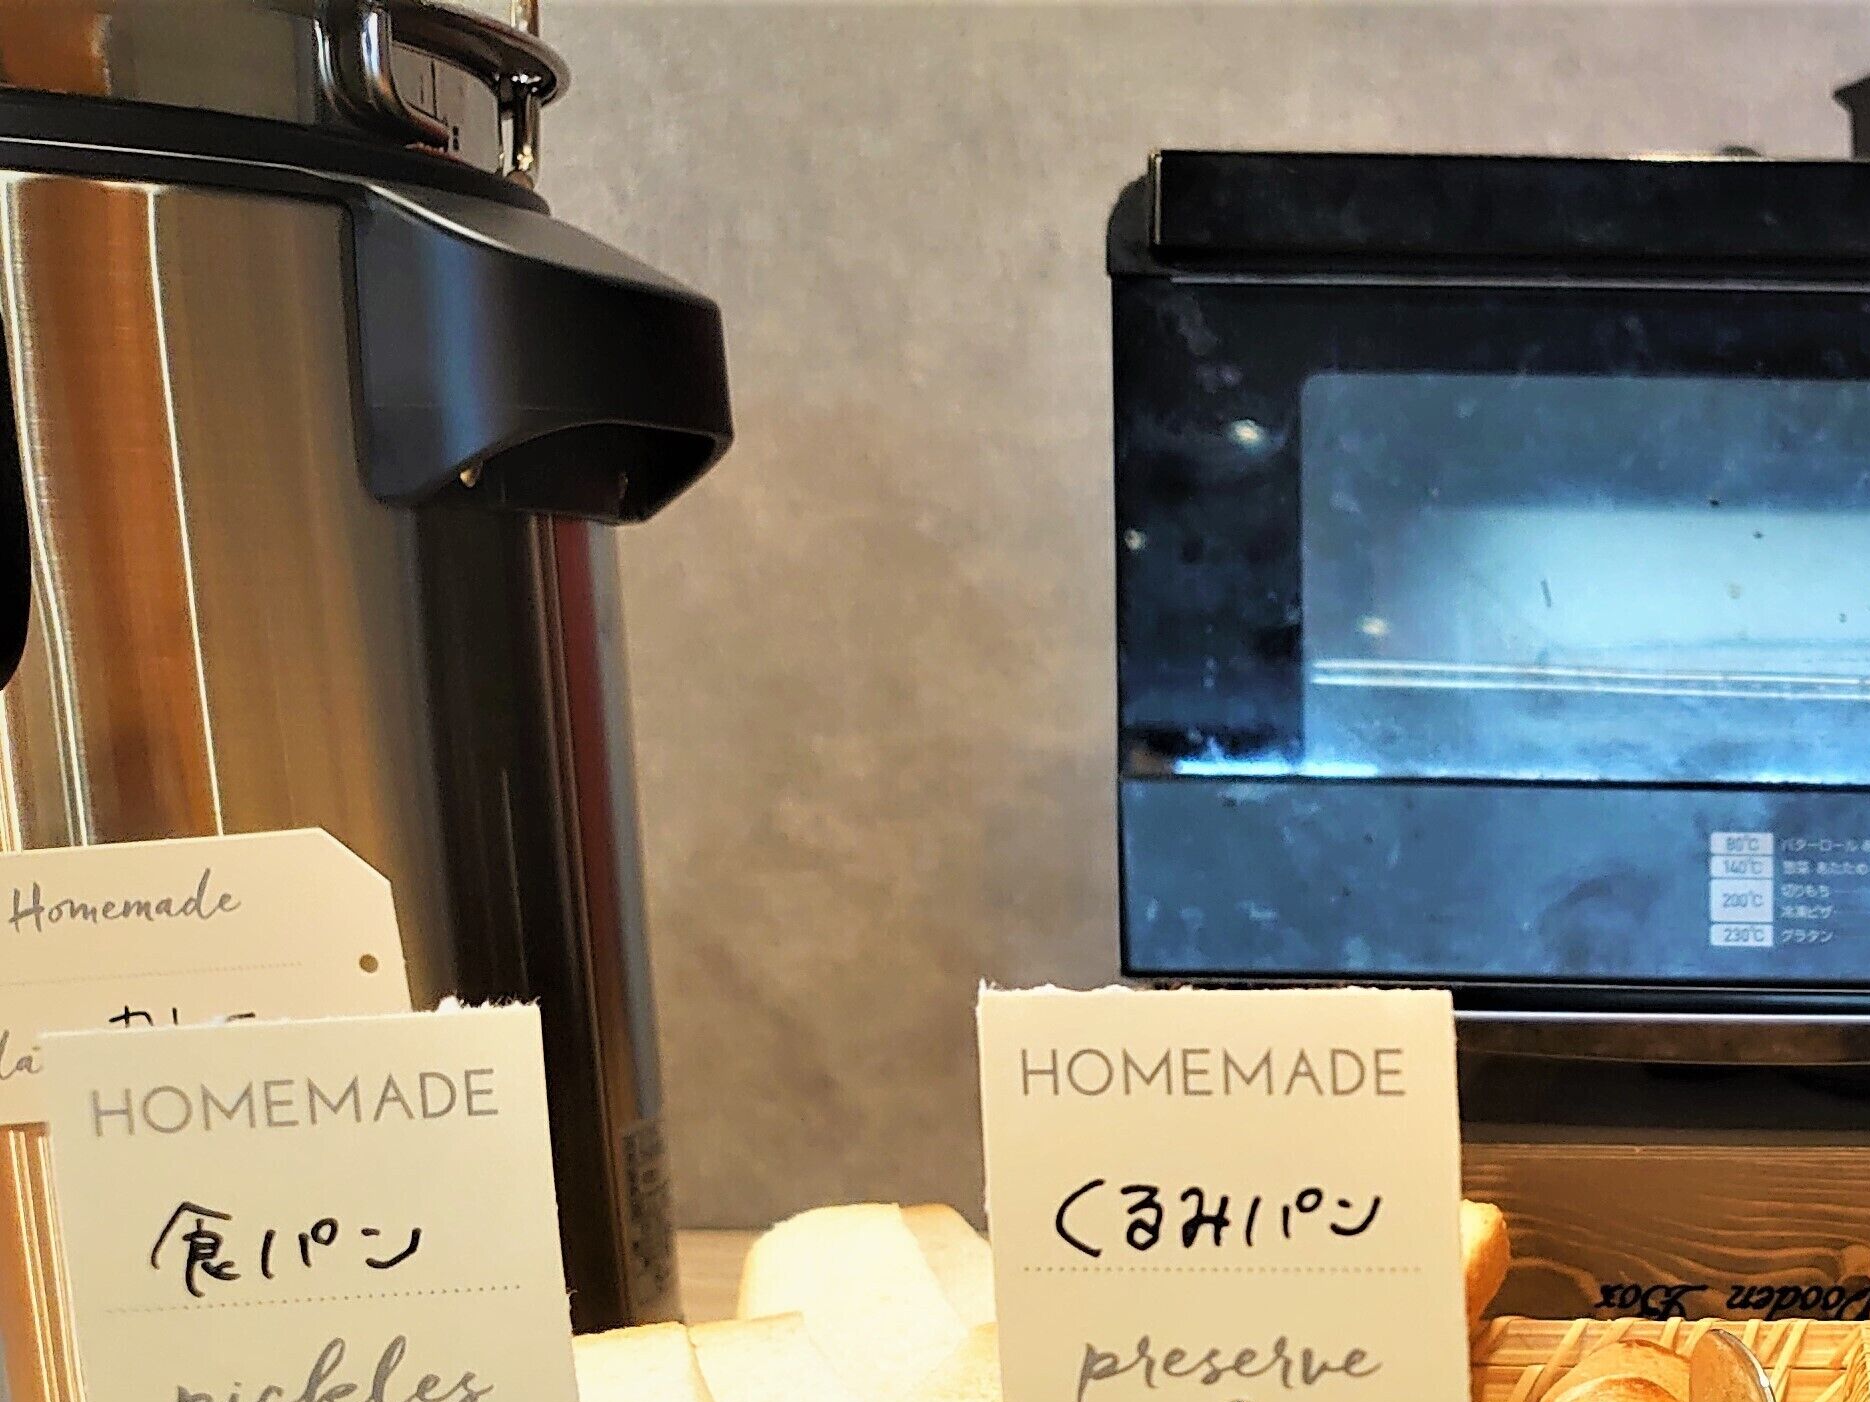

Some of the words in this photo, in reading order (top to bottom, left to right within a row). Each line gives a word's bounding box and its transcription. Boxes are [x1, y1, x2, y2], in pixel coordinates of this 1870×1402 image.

[8, 867, 242, 933] Homemade
[1723, 926, 1765, 944] 230°C
[90, 1067, 500, 1138] HOMEMADE
[1020, 1047, 1406, 1097] HOMEMADE
[150, 1200, 423, 1299] 食パン
[1055, 1178, 1383, 1259] くるみパン
